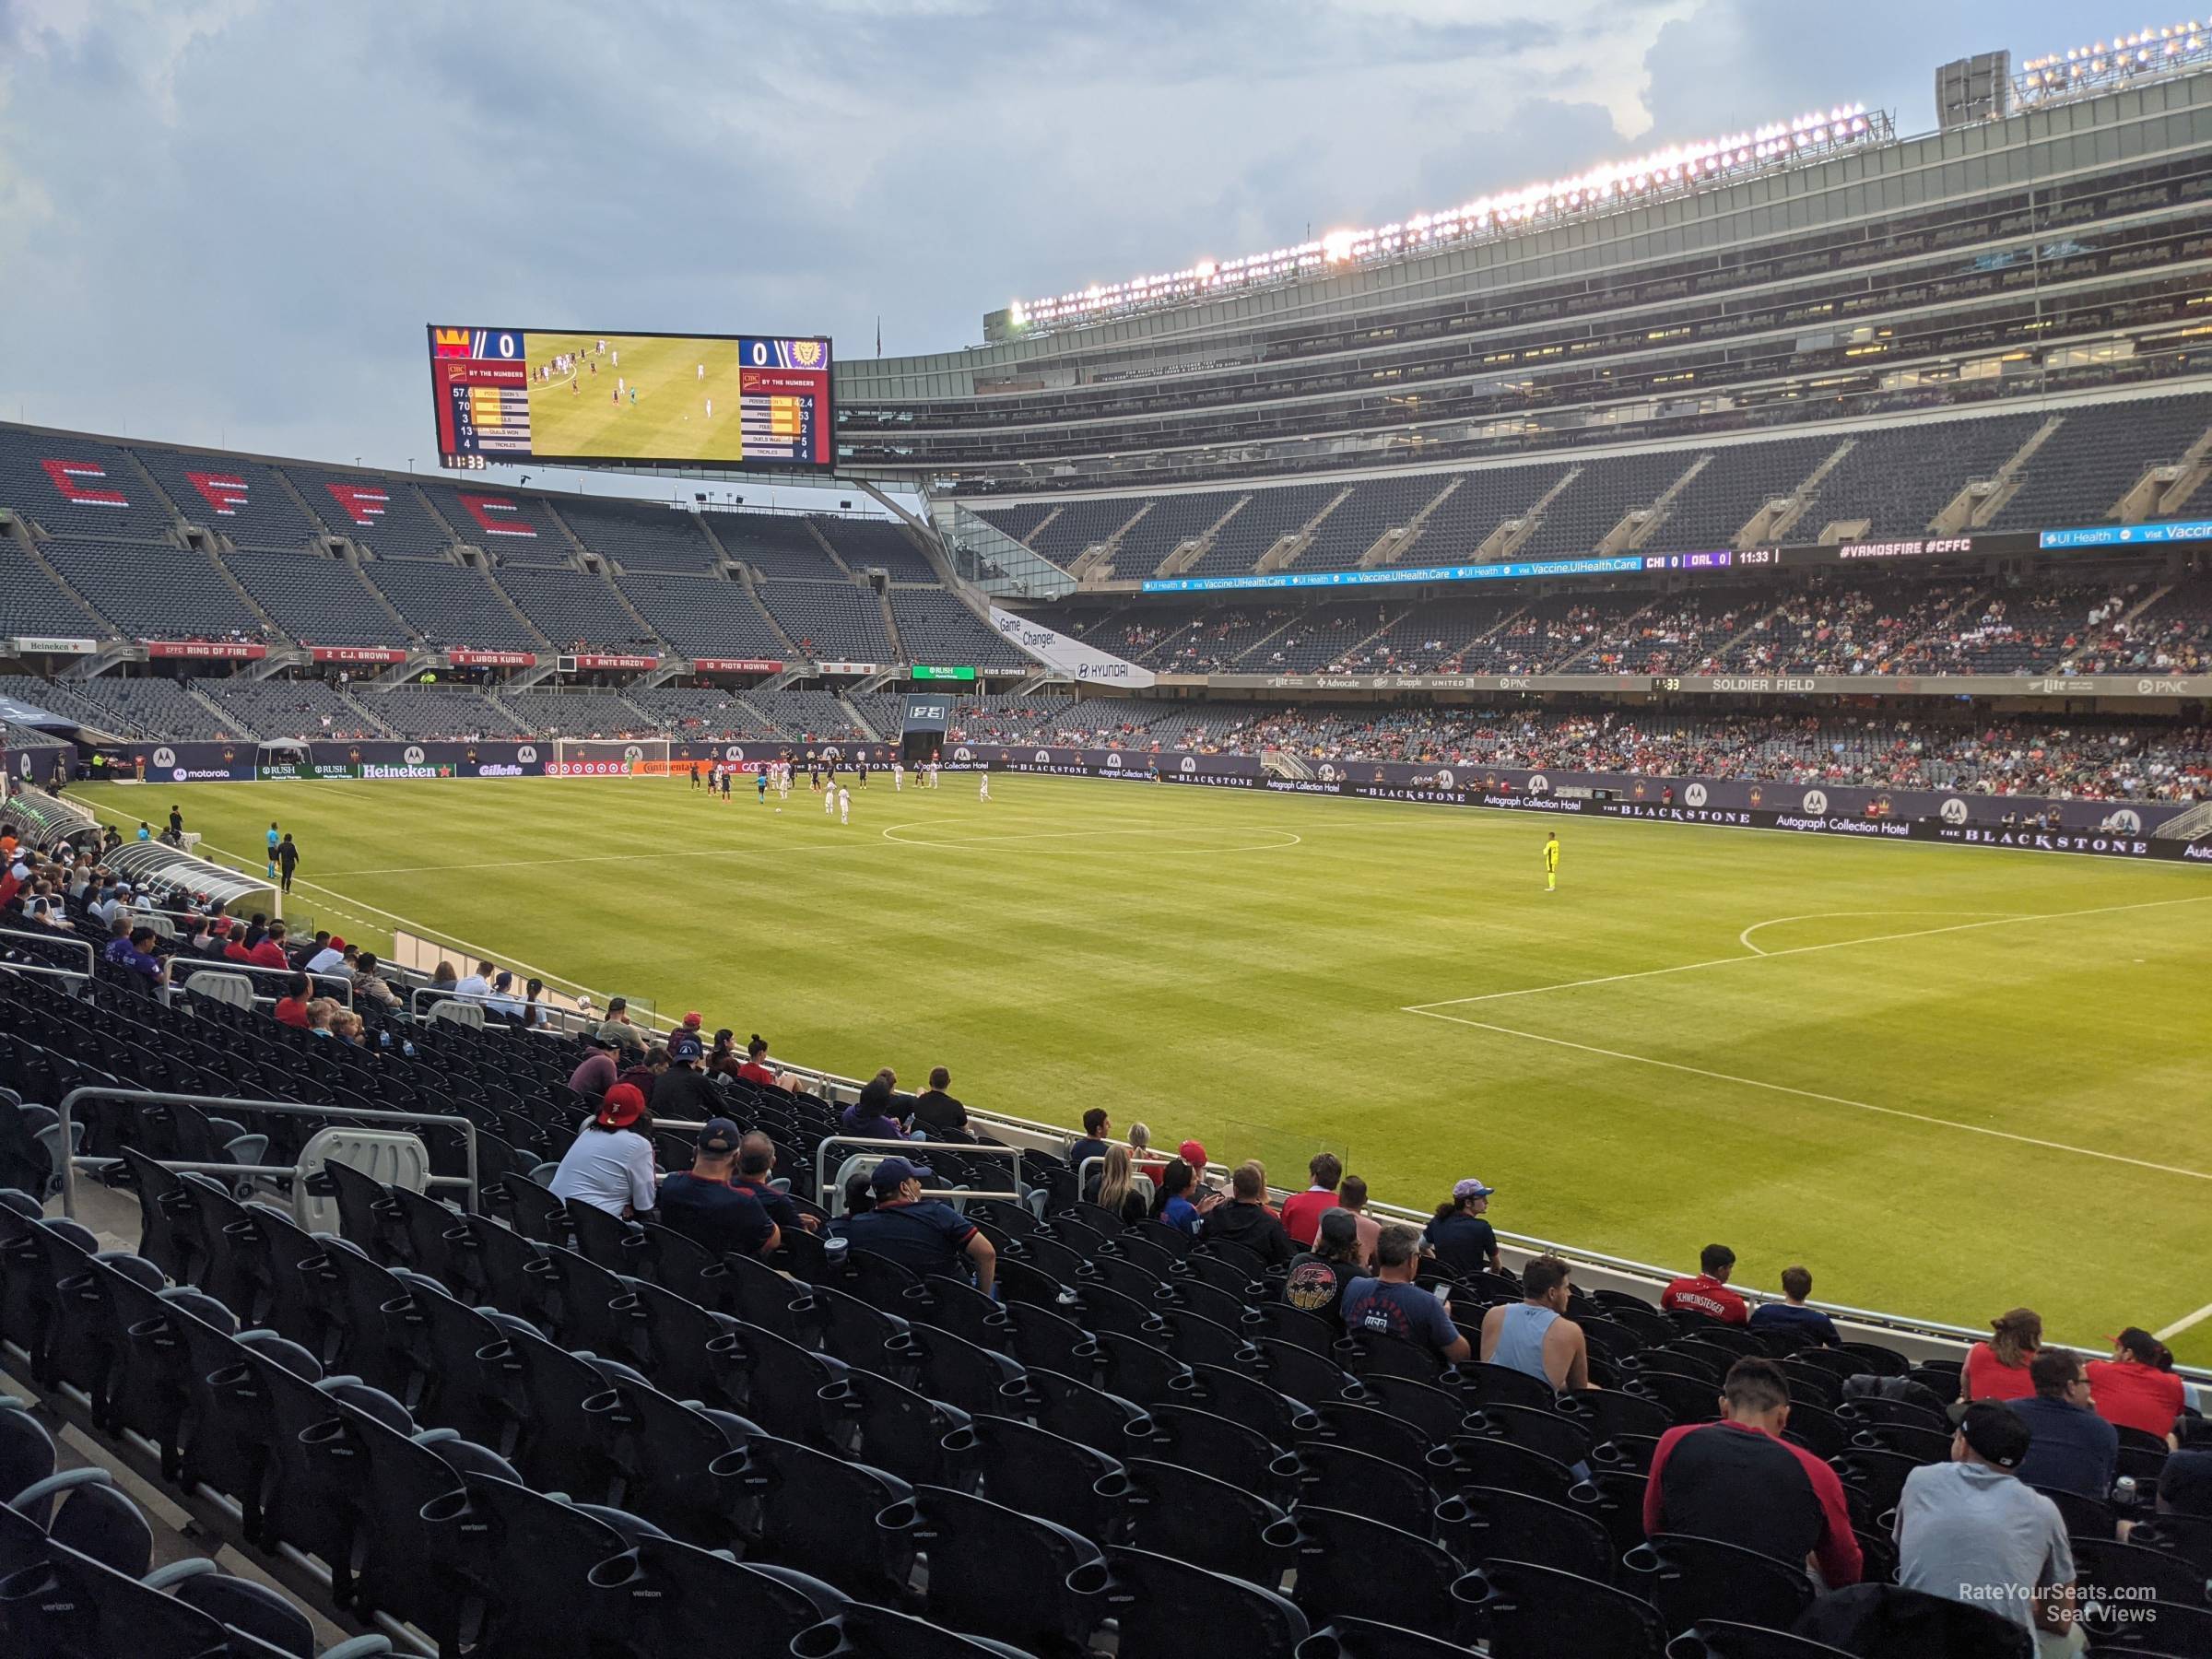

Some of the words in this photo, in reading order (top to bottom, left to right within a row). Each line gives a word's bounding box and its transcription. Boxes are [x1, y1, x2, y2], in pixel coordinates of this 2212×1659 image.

[500, 335, 514, 358] 0
[753, 342, 767, 365] 0
[458, 402, 470, 410] 70
[463, 414, 469, 423] 3
[461, 427, 473, 436] 13
[801, 425, 807, 433] 2
[464, 440, 471, 449] 4
[801, 438, 807, 446] 5
[801, 451, 807, 459] 4
[448, 455, 484, 469] 11:33
[2057, 534, 2070, 544] UI
[2074, 531, 2112, 543] Health
[1840, 542, 1922, 559] #VAMOSFIRE
[1925, 538, 1971, 553] #CFFC
[1646, 557, 1665, 569] CHI
[1671, 556, 1678, 568] 0
[1691, 555, 1713, 566] ORL
[1719, 554, 1726, 565] 0
[1739, 552, 1769, 564] 11:33
[1474, 567, 1499, 576] Health
[1532, 559, 1637, 573] Vaccine.UIHealth.Care
[1358, 570, 1450, 582] Vaccine.UIHealth.Care
[1204, 578, 1286, 589] Vaccine.UIHealth.Care
[1000, 618, 1021, 632] Game
[1022, 631, 1056, 648] Changer.
[30, 641, 69, 652] Heineken
[187, 646, 210, 655] RING
[213, 647, 226, 655] OF
[228, 647, 248, 656] FIRE
[340, 651, 357, 659] C.J.
[359, 652, 390, 660] BROWN
[619, 659, 644, 667] RAZOV
[935, 666, 954, 675] RUSH
[1091, 665, 1128, 677] HYUNDAI
[1326, 678, 1359, 688] Advocate
[1395, 678, 1422, 688] Snapple
[1511, 679, 1532, 688] PNC
[1712, 678, 1769, 690] SOLDIER
[1776, 679, 1815, 691] FIELD
[2042, 679, 2066, 693] Lite
[2155, 680, 2189, 692] PNC
[270, 766, 295, 774] RUSH
[323, 765, 347, 773] RUSH
[362, 764, 437, 779] Heineken
[479, 764, 524, 776] Gillette
[944, 761, 971, 770] Collection
[972, 761, 989, 770] Hotel
[1019, 763, 1088, 775] BLACKSTONE
[187, 769, 230, 779] motorola
[1098, 768, 1121, 778] Autograph
[1121, 769, 1145, 779] Collection
[1179, 774, 1253, 787] BLACKSTONE
[1266, 780, 1295, 792] Autograph
[1296, 781, 1324, 792] Collection
[1324, 782, 1340, 793] Hotel
[1370, 787, 1465, 802] BLACKSTONE
[1484, 794, 1521, 807] Autograph
[1523, 796, 1559, 809] Collection
[1560, 798, 1582, 810] Hotel
[1620, 805, 1750, 823] BLACKSTONE
[1776, 815, 1827, 831] Autograph
[1829, 818, 1878, 833] Collection
[1881, 822, 1910, 835] Hotel
[1965, 830, 2147, 854] BLACKSTONE
[1676, 1291, 1725, 1315] SCHWEINSTEIGER
[460, 1523, 488, 1532] verizon
[632, 1589, 661, 1597] verizon
[41, 1602, 74, 1611] verizon
